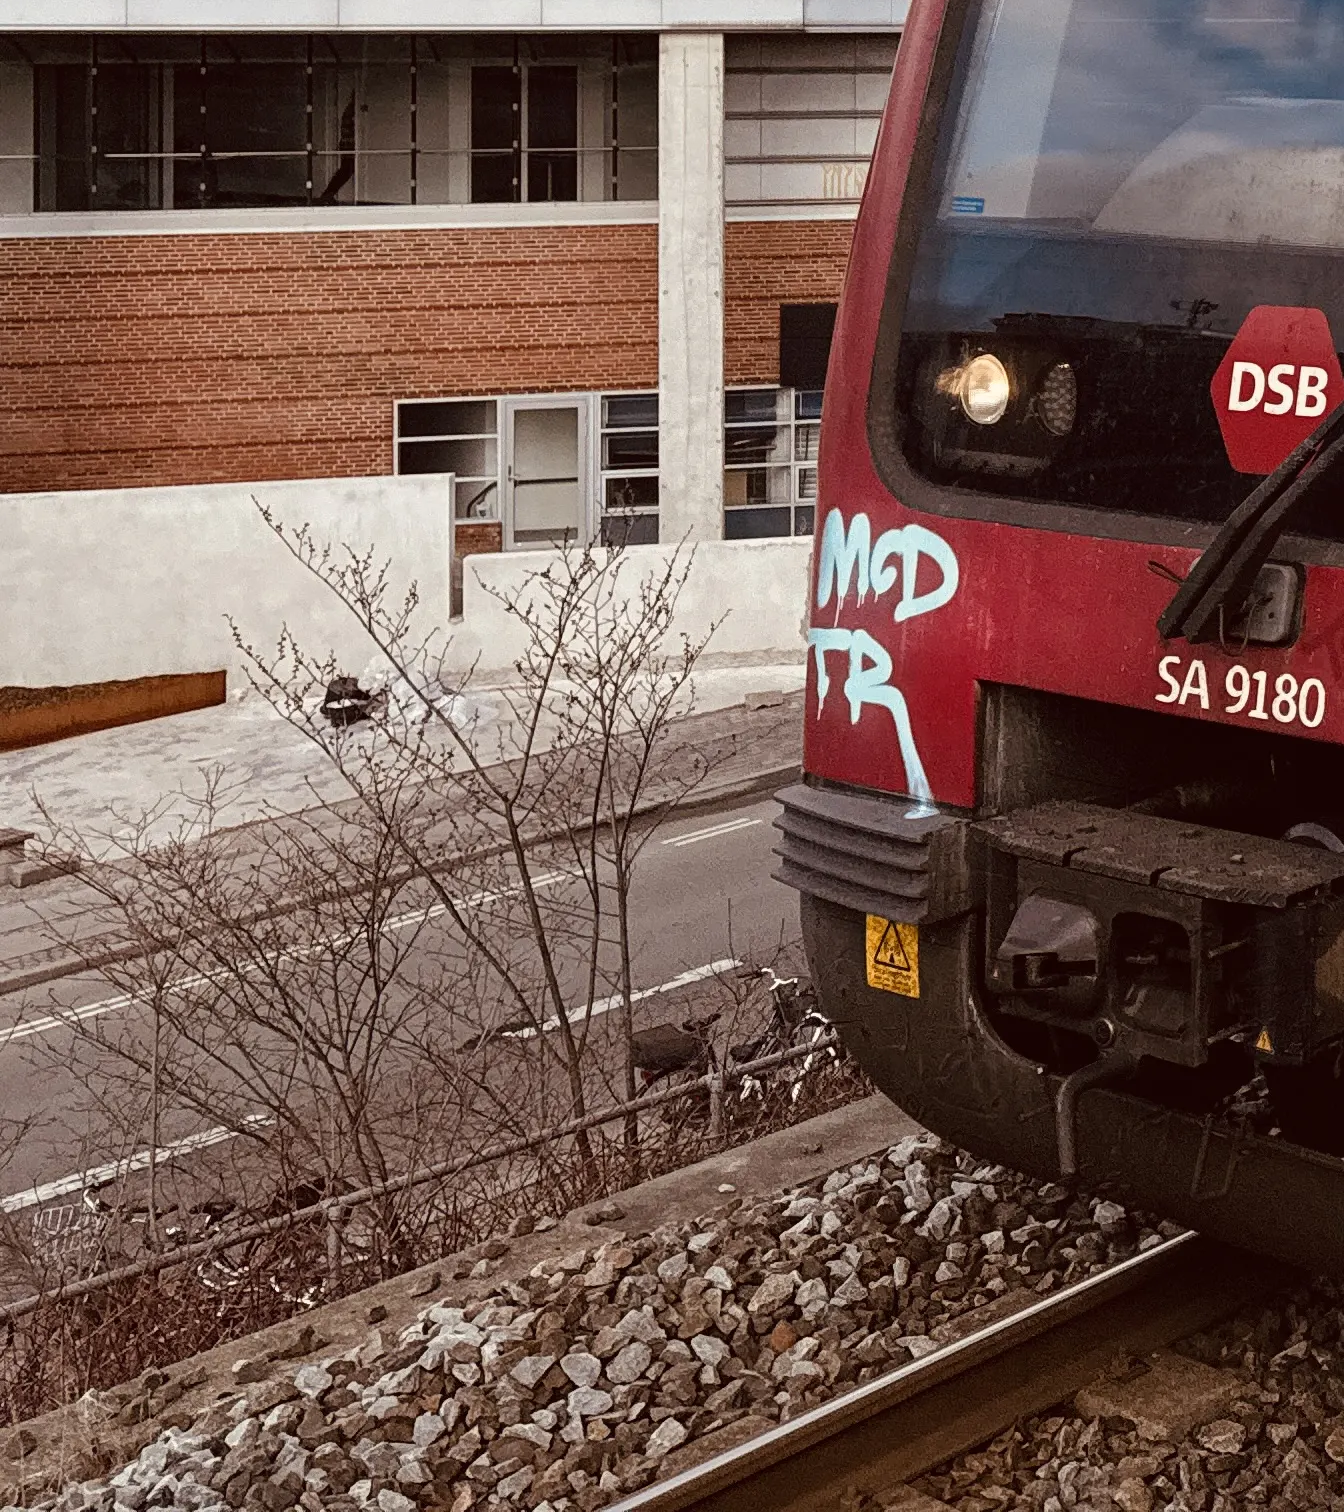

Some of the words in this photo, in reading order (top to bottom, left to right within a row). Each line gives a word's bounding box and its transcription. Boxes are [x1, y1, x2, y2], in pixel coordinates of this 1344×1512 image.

[1228, 361, 1328, 417] DSB
[1154, 655, 1210, 710] SA
[1225, 664, 1326, 728] 9180
